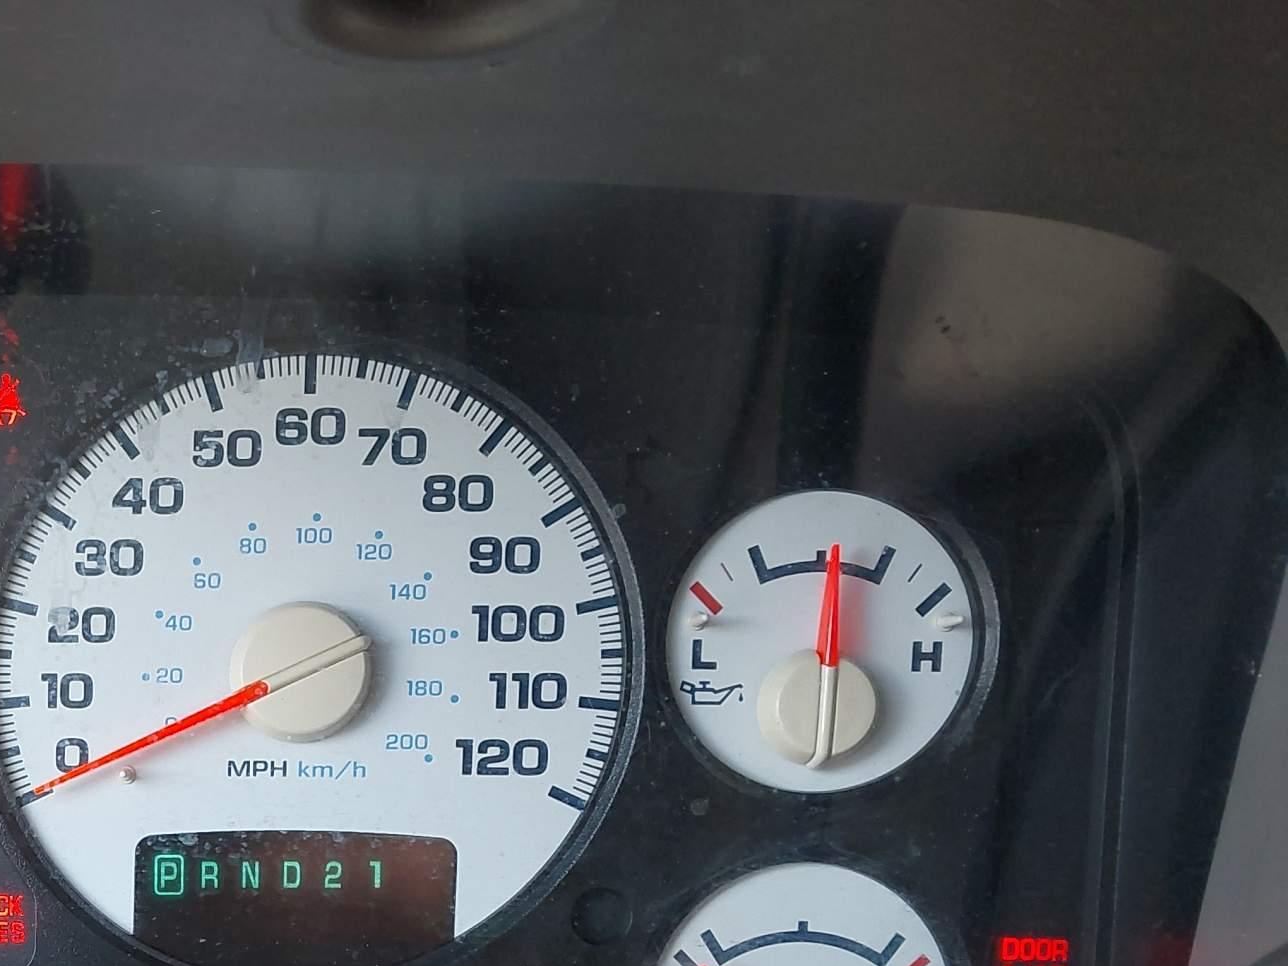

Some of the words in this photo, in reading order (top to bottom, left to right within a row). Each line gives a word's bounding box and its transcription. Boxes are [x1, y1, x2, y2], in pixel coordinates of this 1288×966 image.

[275, 408, 345, 445] 60
[192, 430, 261, 467] 50
[358, 428, 426, 465] 70
[113, 477, 184, 514] 40
[422, 475, 494, 512] 80
[239, 538, 267, 554] 80
[296, 528, 333, 544] 100
[75, 539, 144, 576] 30
[356, 544, 392, 561] 120
[469, 537, 540, 574] 90
[193, 572, 221, 589] 60
[389, 583, 426, 600] 140
[47, 607, 115, 643] 20
[165, 615, 192, 631] 40
[410, 627, 446, 644] 160
[471, 605, 564, 642] 100
[692, 640, 716, 670] L
[912, 641, 942, 672] H
[41, 673, 94, 709] 10
[156, 668, 183, 684] 20
[407, 680, 443, 697] 180
[489, 673, 567, 709] 110
[56, 738, 89, 773] 0
[386, 734, 428, 750] 200
[227, 760, 288, 778] MPH
[298, 760, 366, 779] km/h
[455, 739, 548, 776] 120
[161, 862, 177, 888] P
[202, 862, 218, 888] R
[243, 862, 259, 888] N
[284, 862, 301, 888] D
[325, 861, 342, 888] 2
[370, 861, 381, 888] 1
[1002, 937, 1068, 961] DOOR
